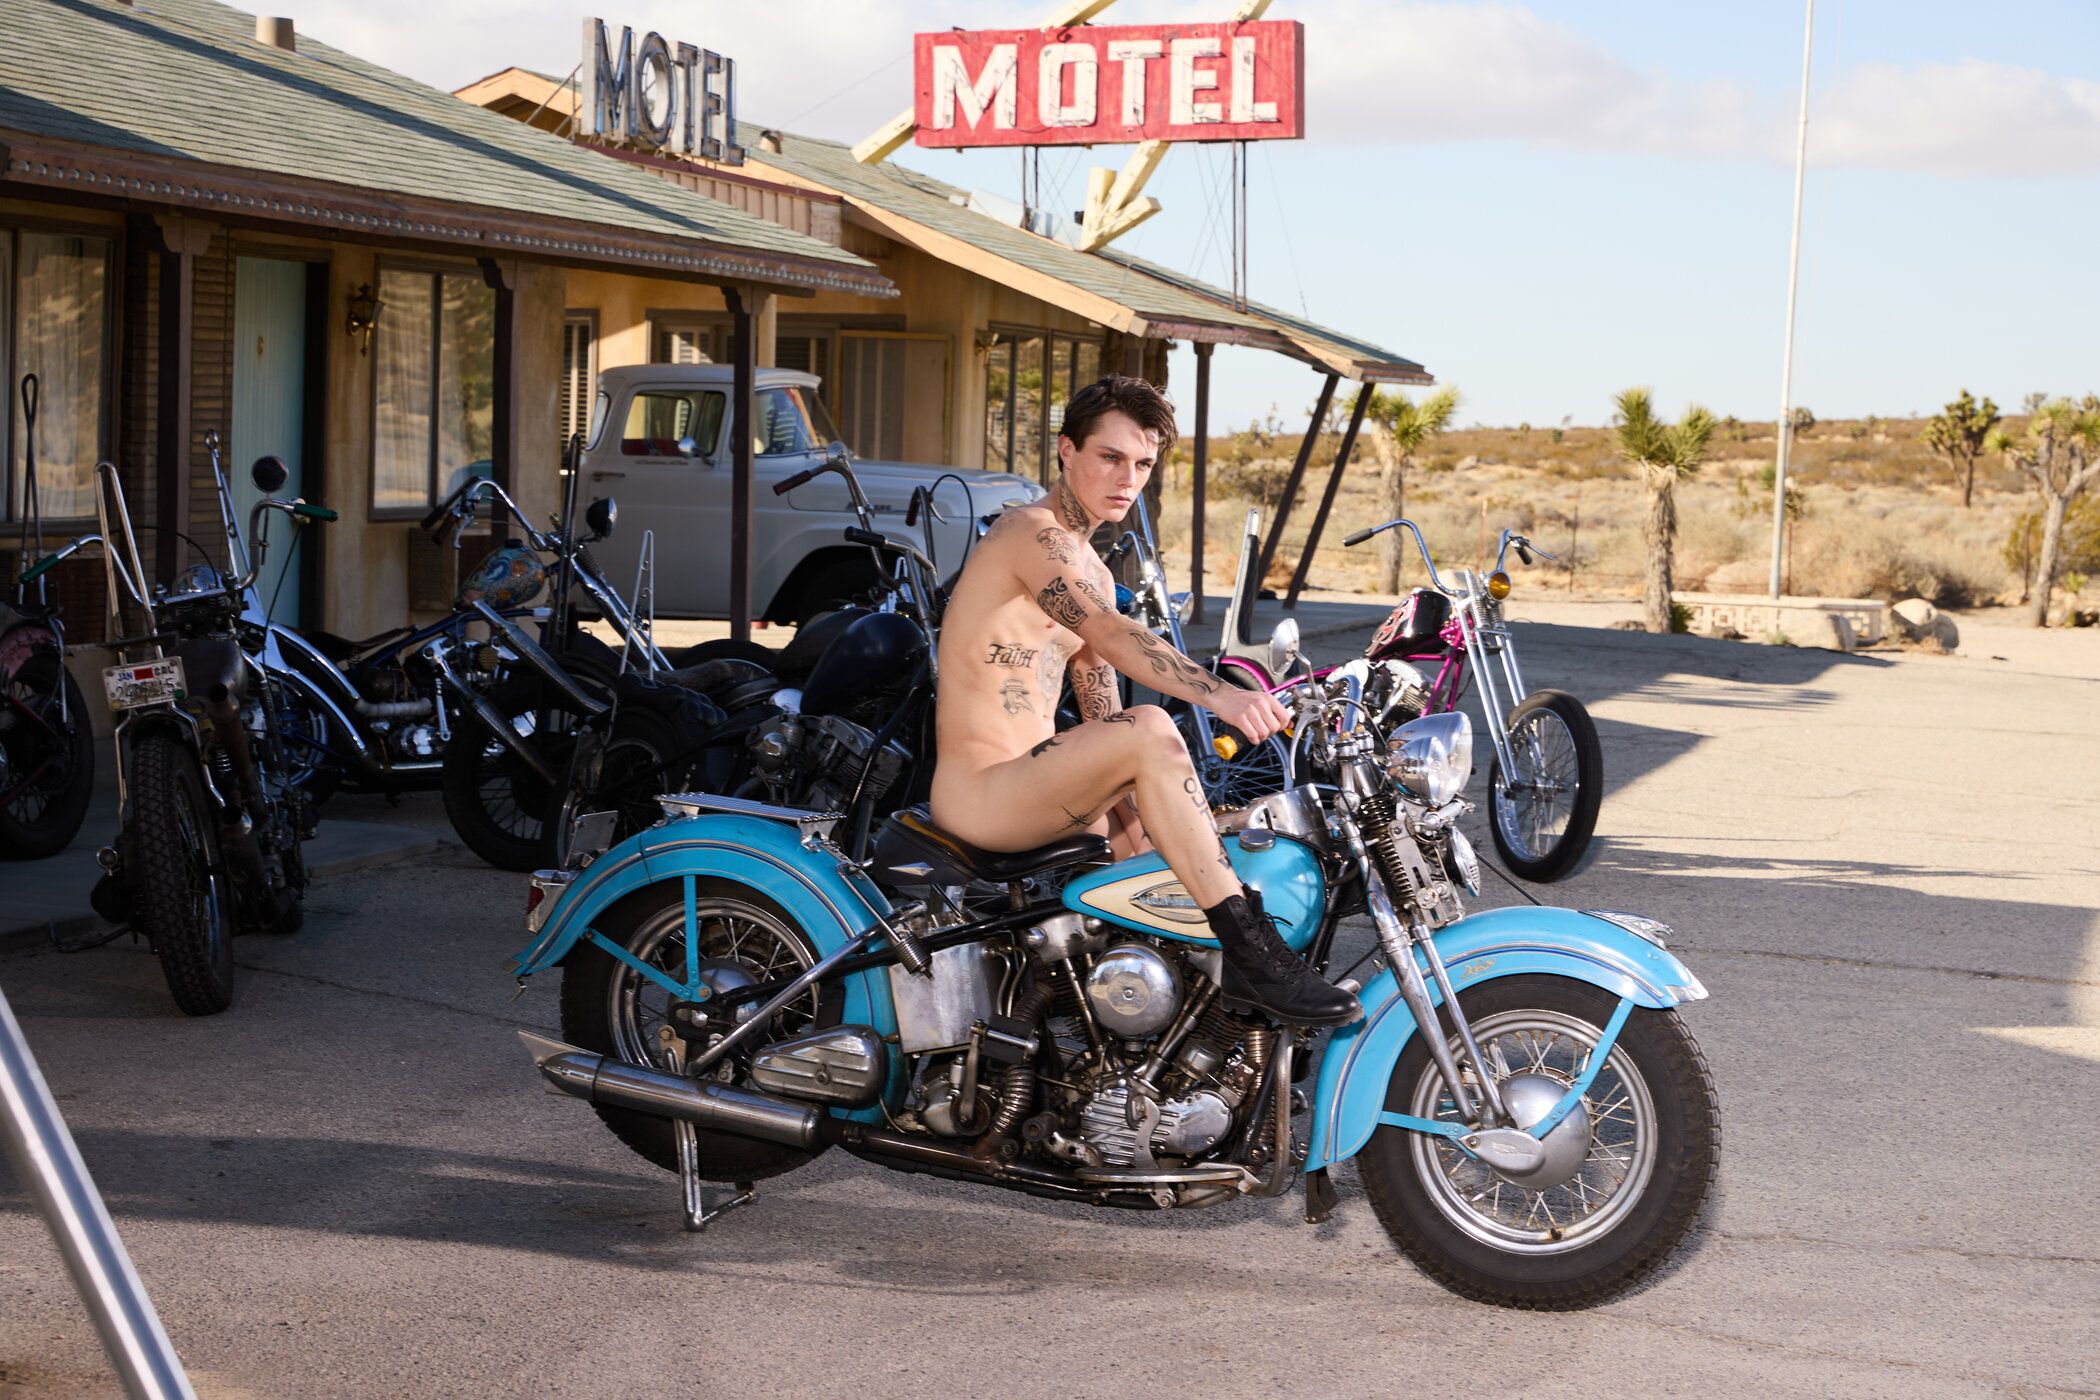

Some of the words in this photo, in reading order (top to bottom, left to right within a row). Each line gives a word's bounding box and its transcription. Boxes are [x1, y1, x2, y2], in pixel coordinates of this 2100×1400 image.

[581, 16, 747, 167] MOTEL
[933, 36, 1280, 131] MOTEL
[117, 672, 133, 682] JAN
[154, 665, 174, 676] CAL
